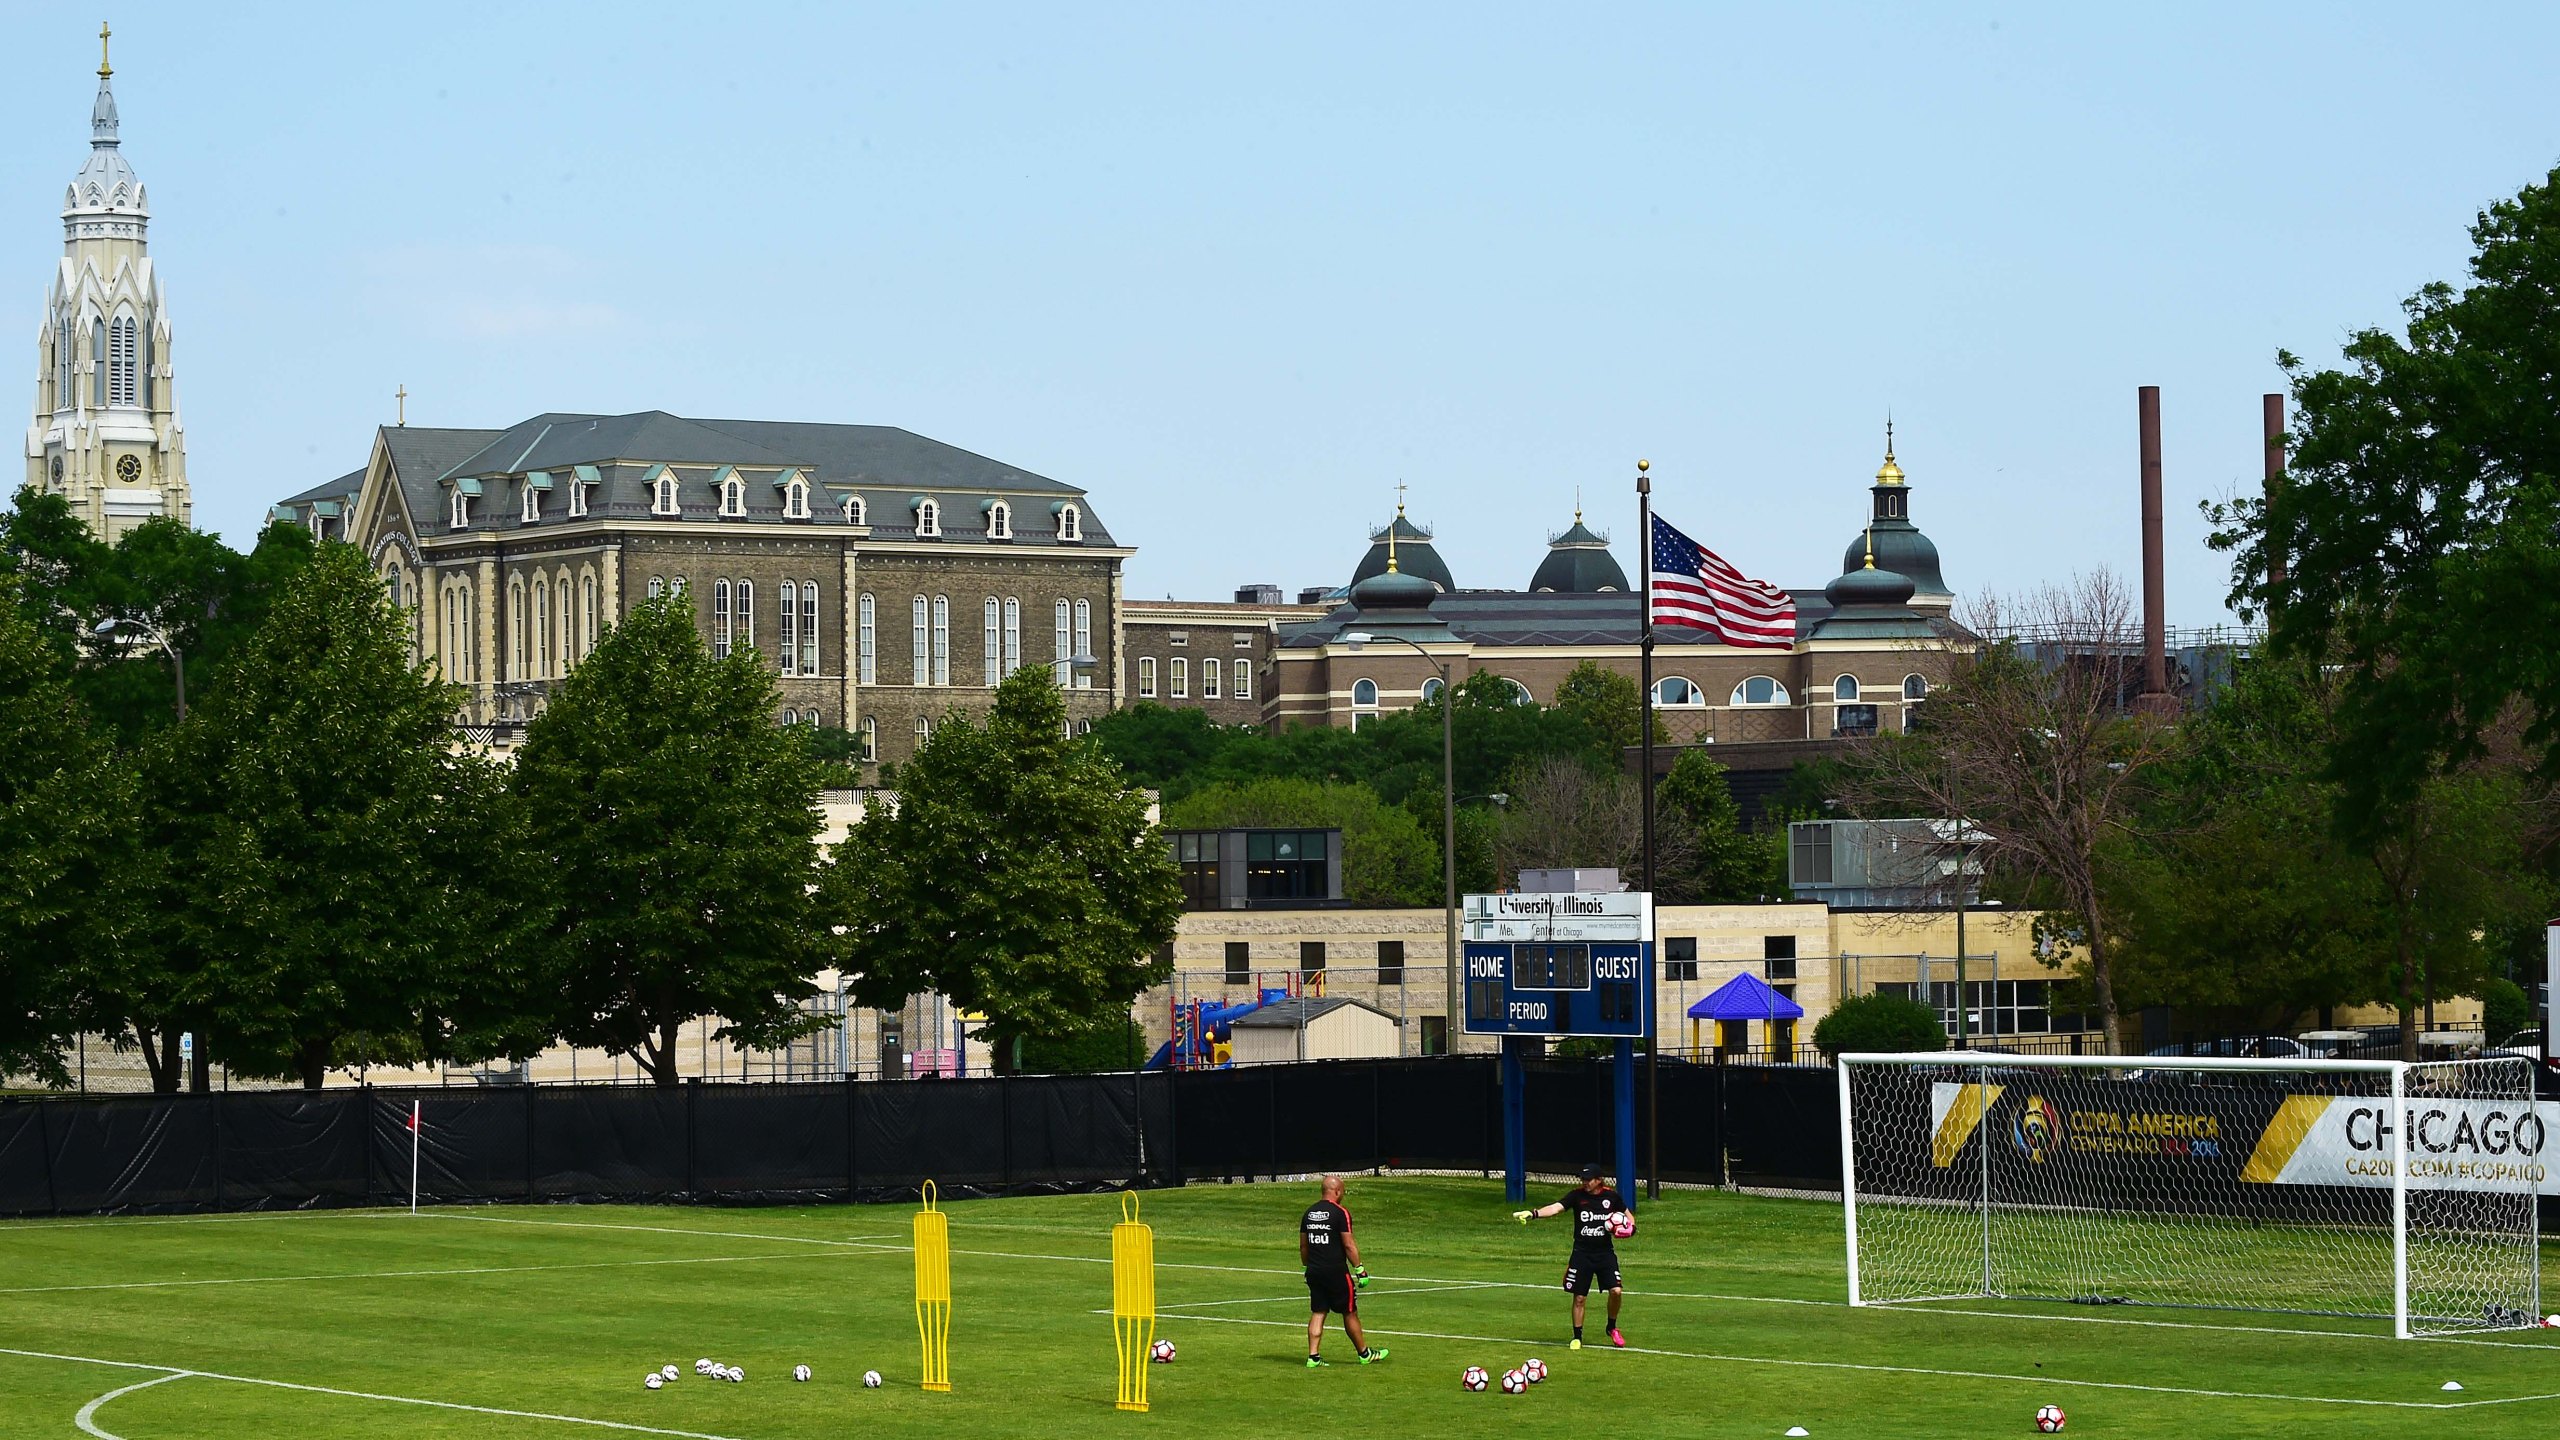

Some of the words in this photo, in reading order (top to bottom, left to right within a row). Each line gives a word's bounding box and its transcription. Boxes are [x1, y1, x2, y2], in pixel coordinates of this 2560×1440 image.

[396, 531, 418, 564] COLLEGE
[1499, 897, 1555, 916] University
[1555, 901, 1563, 914] of
[1563, 895, 1603, 914] Illinois
[1562, 926, 1583, 938] Chicago
[1470, 956, 1504, 977] HOME
[1595, 956, 1638, 979] GUEST
[1509, 1002, 1547, 1020] PERIOD
[2070, 1111, 2122, 1134] COPA
[2127, 1112, 2220, 1138] AMERICA
[2345, 1107, 2545, 1157] CHICAGO
[2070, 1135, 2160, 1154] CENTENARIO
[2191, 1140, 2220, 1158] 2016
[2345, 1157, 2454, 1179] CA201.COM
[2457, 1162, 2545, 1183] #COPA100
